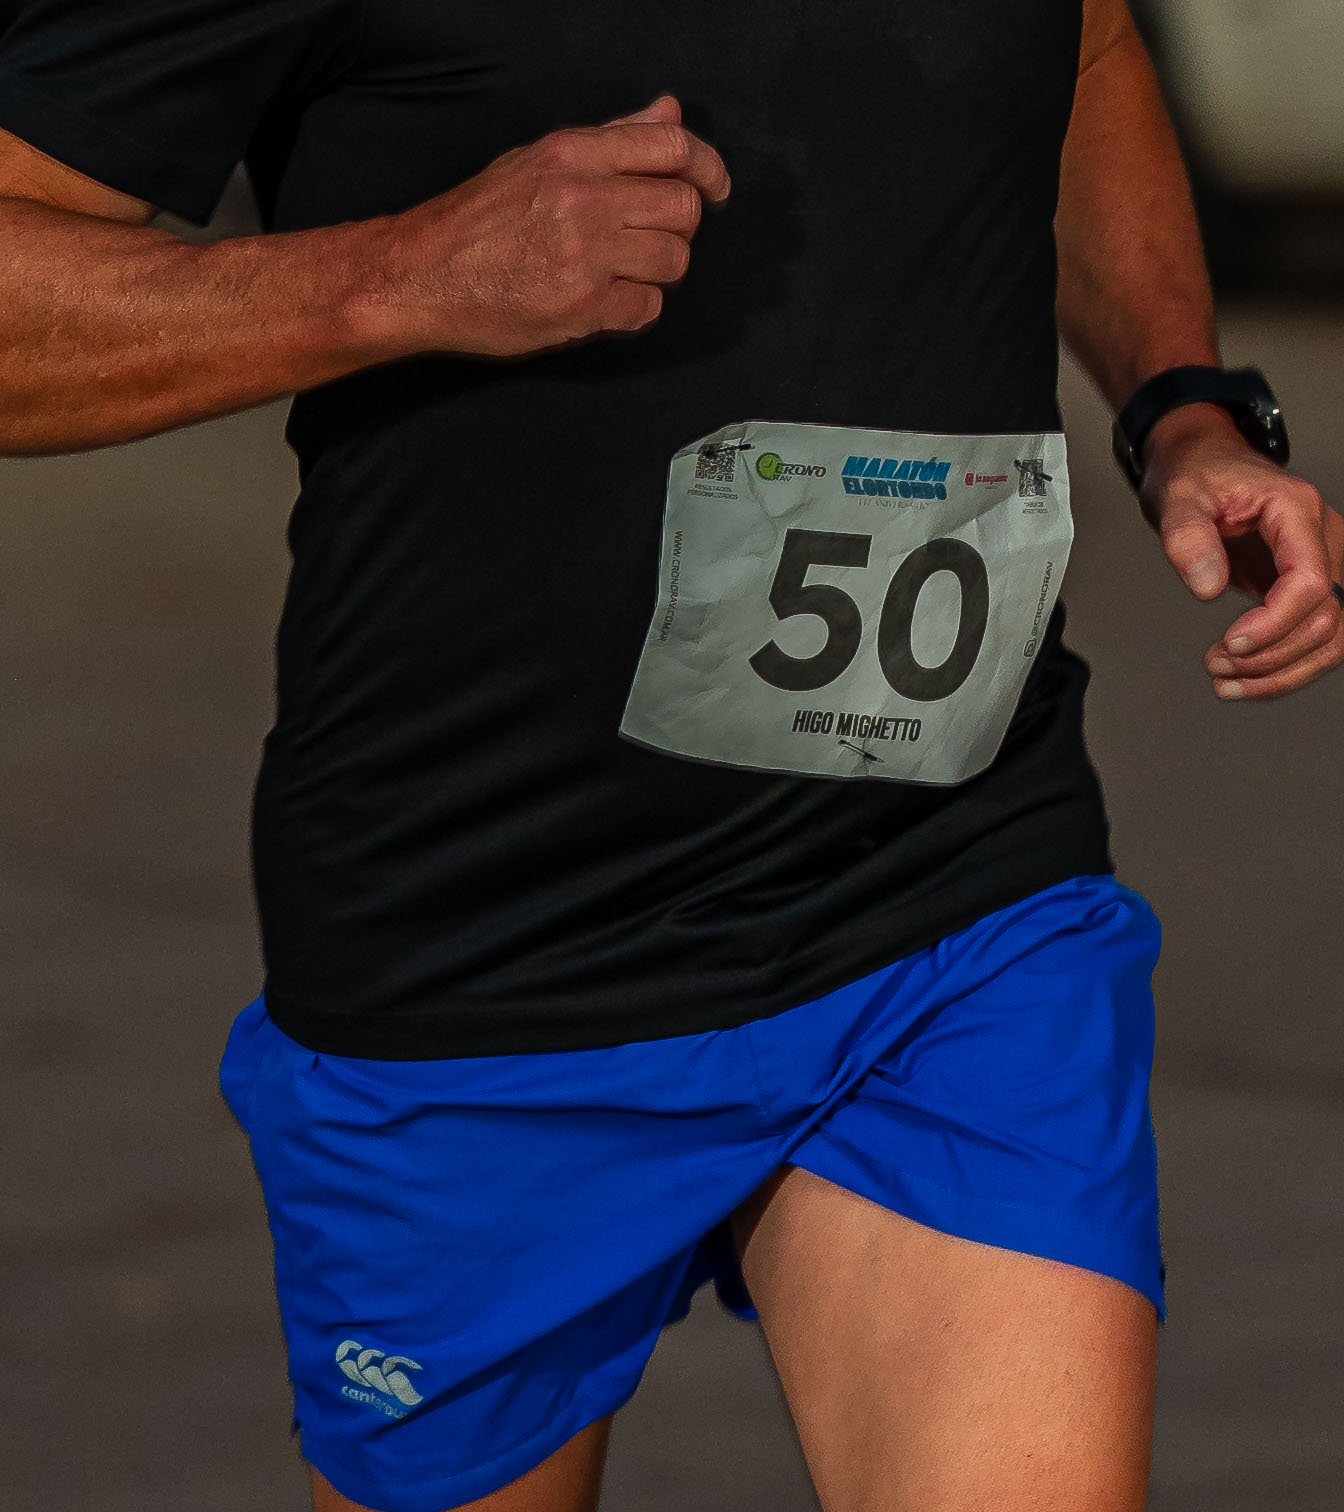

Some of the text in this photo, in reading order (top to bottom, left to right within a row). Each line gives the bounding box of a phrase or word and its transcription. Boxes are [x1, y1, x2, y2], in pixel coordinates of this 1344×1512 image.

[748, 527, 991, 704] 50
[791, 709, 922, 742] HIGO MIGHETTO
